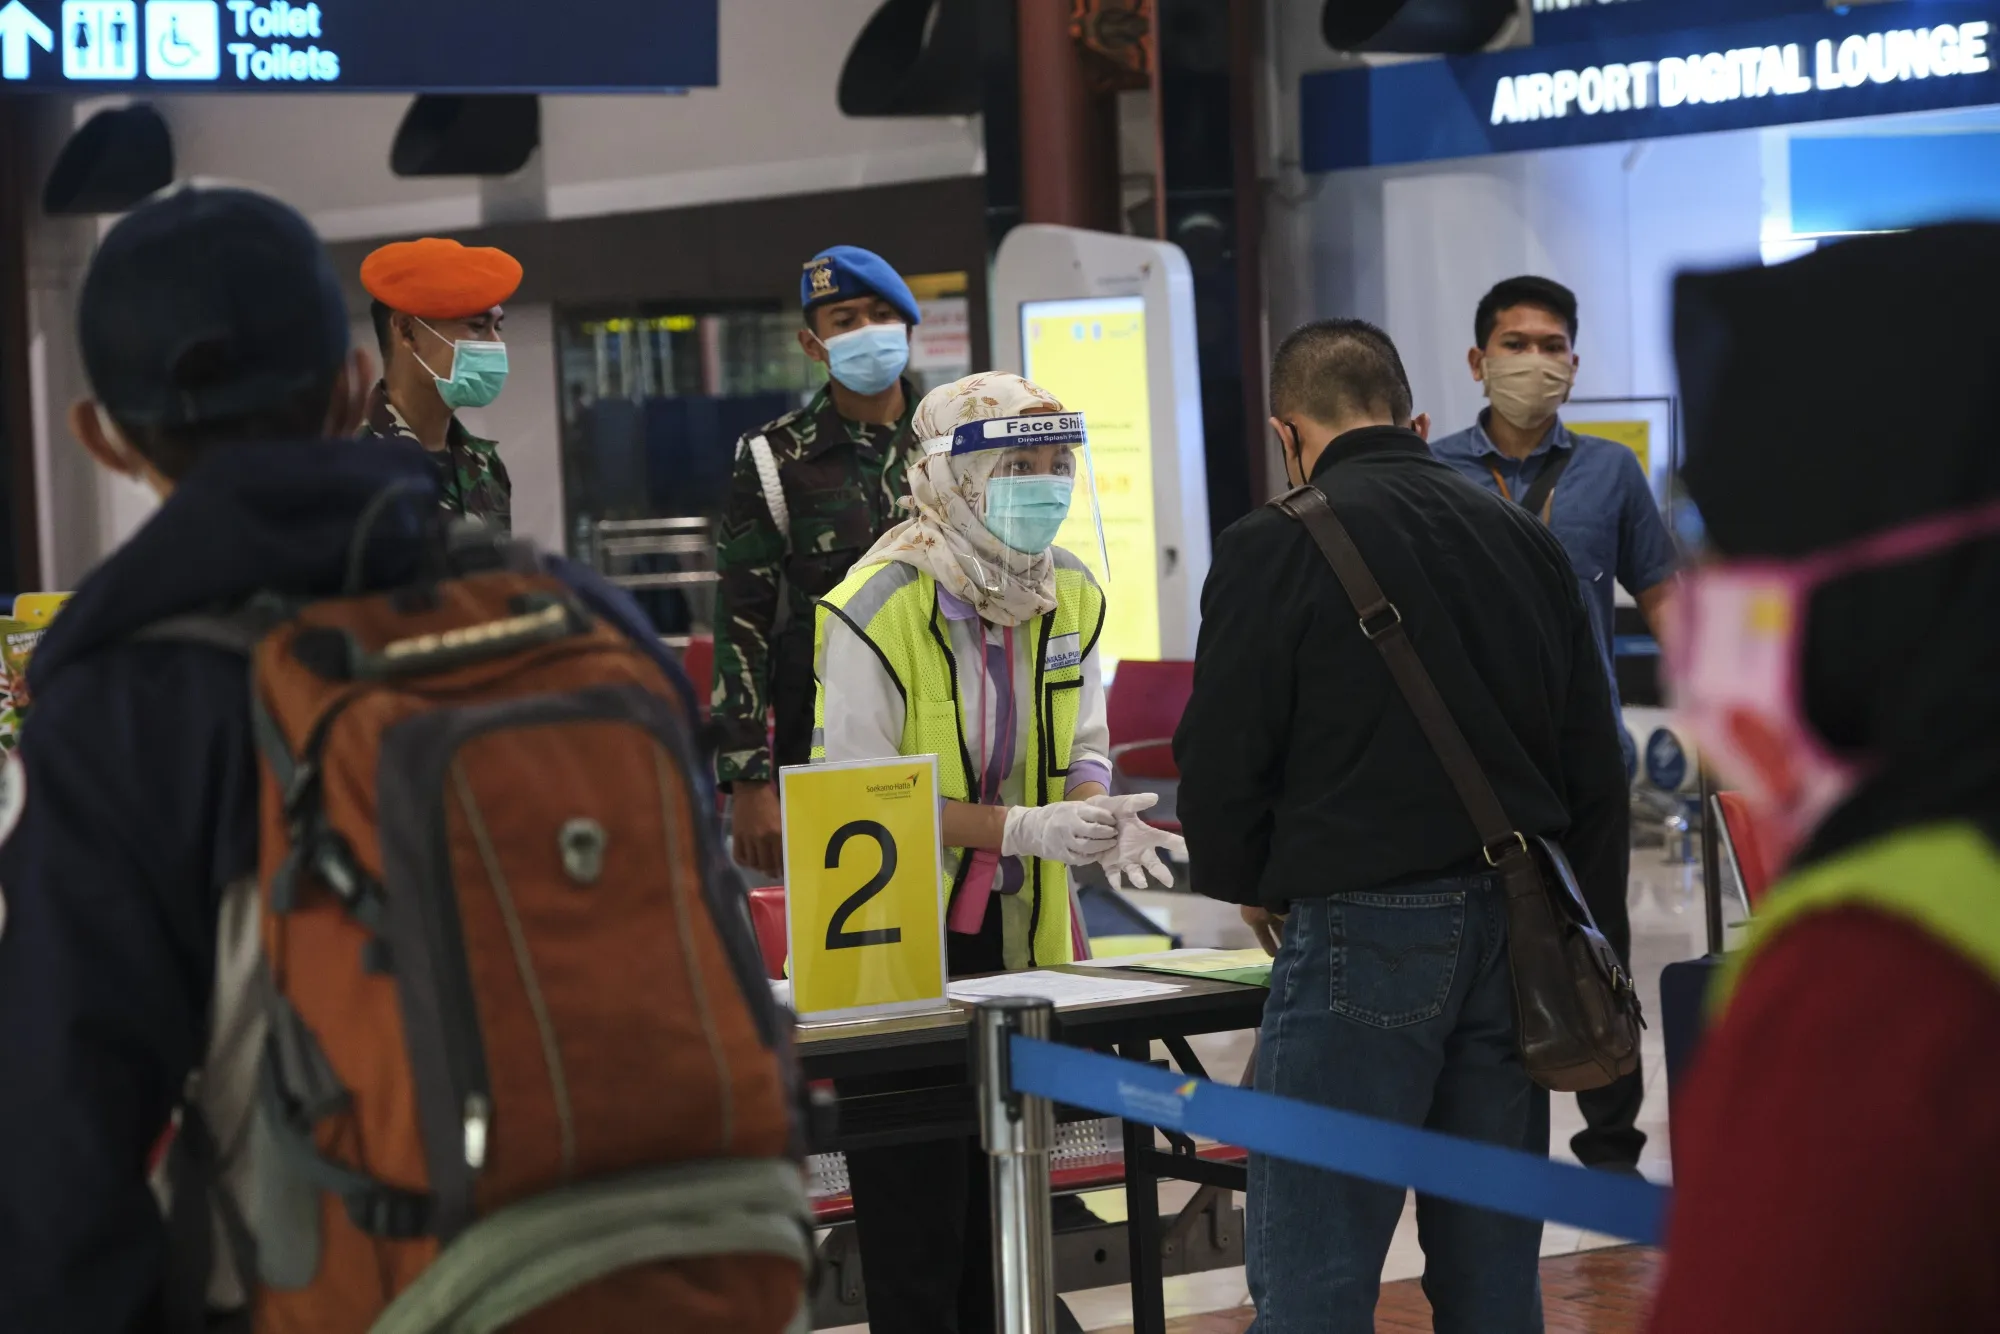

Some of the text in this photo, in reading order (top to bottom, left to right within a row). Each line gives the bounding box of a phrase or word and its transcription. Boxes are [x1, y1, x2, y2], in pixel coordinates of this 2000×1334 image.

[226, 0, 322, 37] Toilet
[226, 43, 340, 80] Toilets
[1490, 20, 1990, 125] AIRPORT DIGITAL LOUNGE
[1007, 421, 1053, 433] Face
[1044, 434, 1067, 442] Splash
[825, 820, 901, 950] 2
